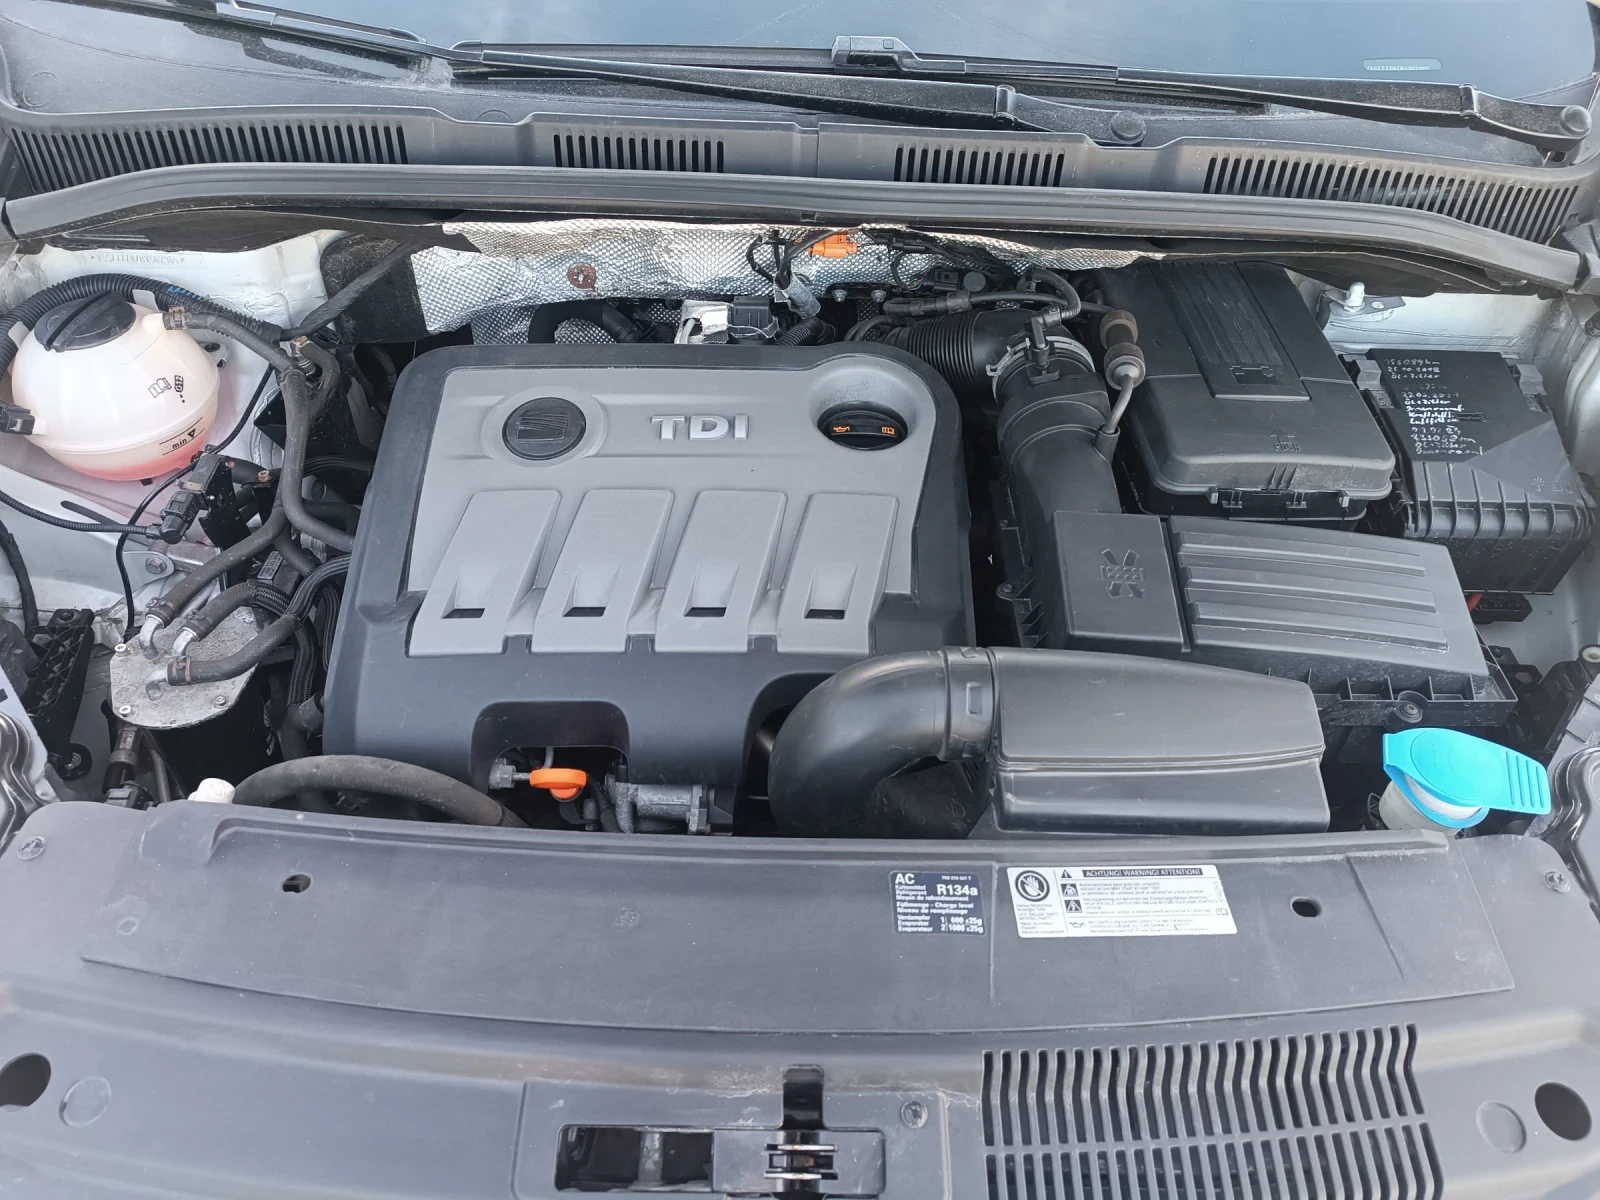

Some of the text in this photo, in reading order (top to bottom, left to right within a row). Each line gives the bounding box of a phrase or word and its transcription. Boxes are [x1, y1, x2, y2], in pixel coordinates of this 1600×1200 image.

[650, 415, 750, 441] TDI
[172, 438, 187, 450] min
[895, 873, 915, 884] AC
[936, 884, 978, 895] R134a
